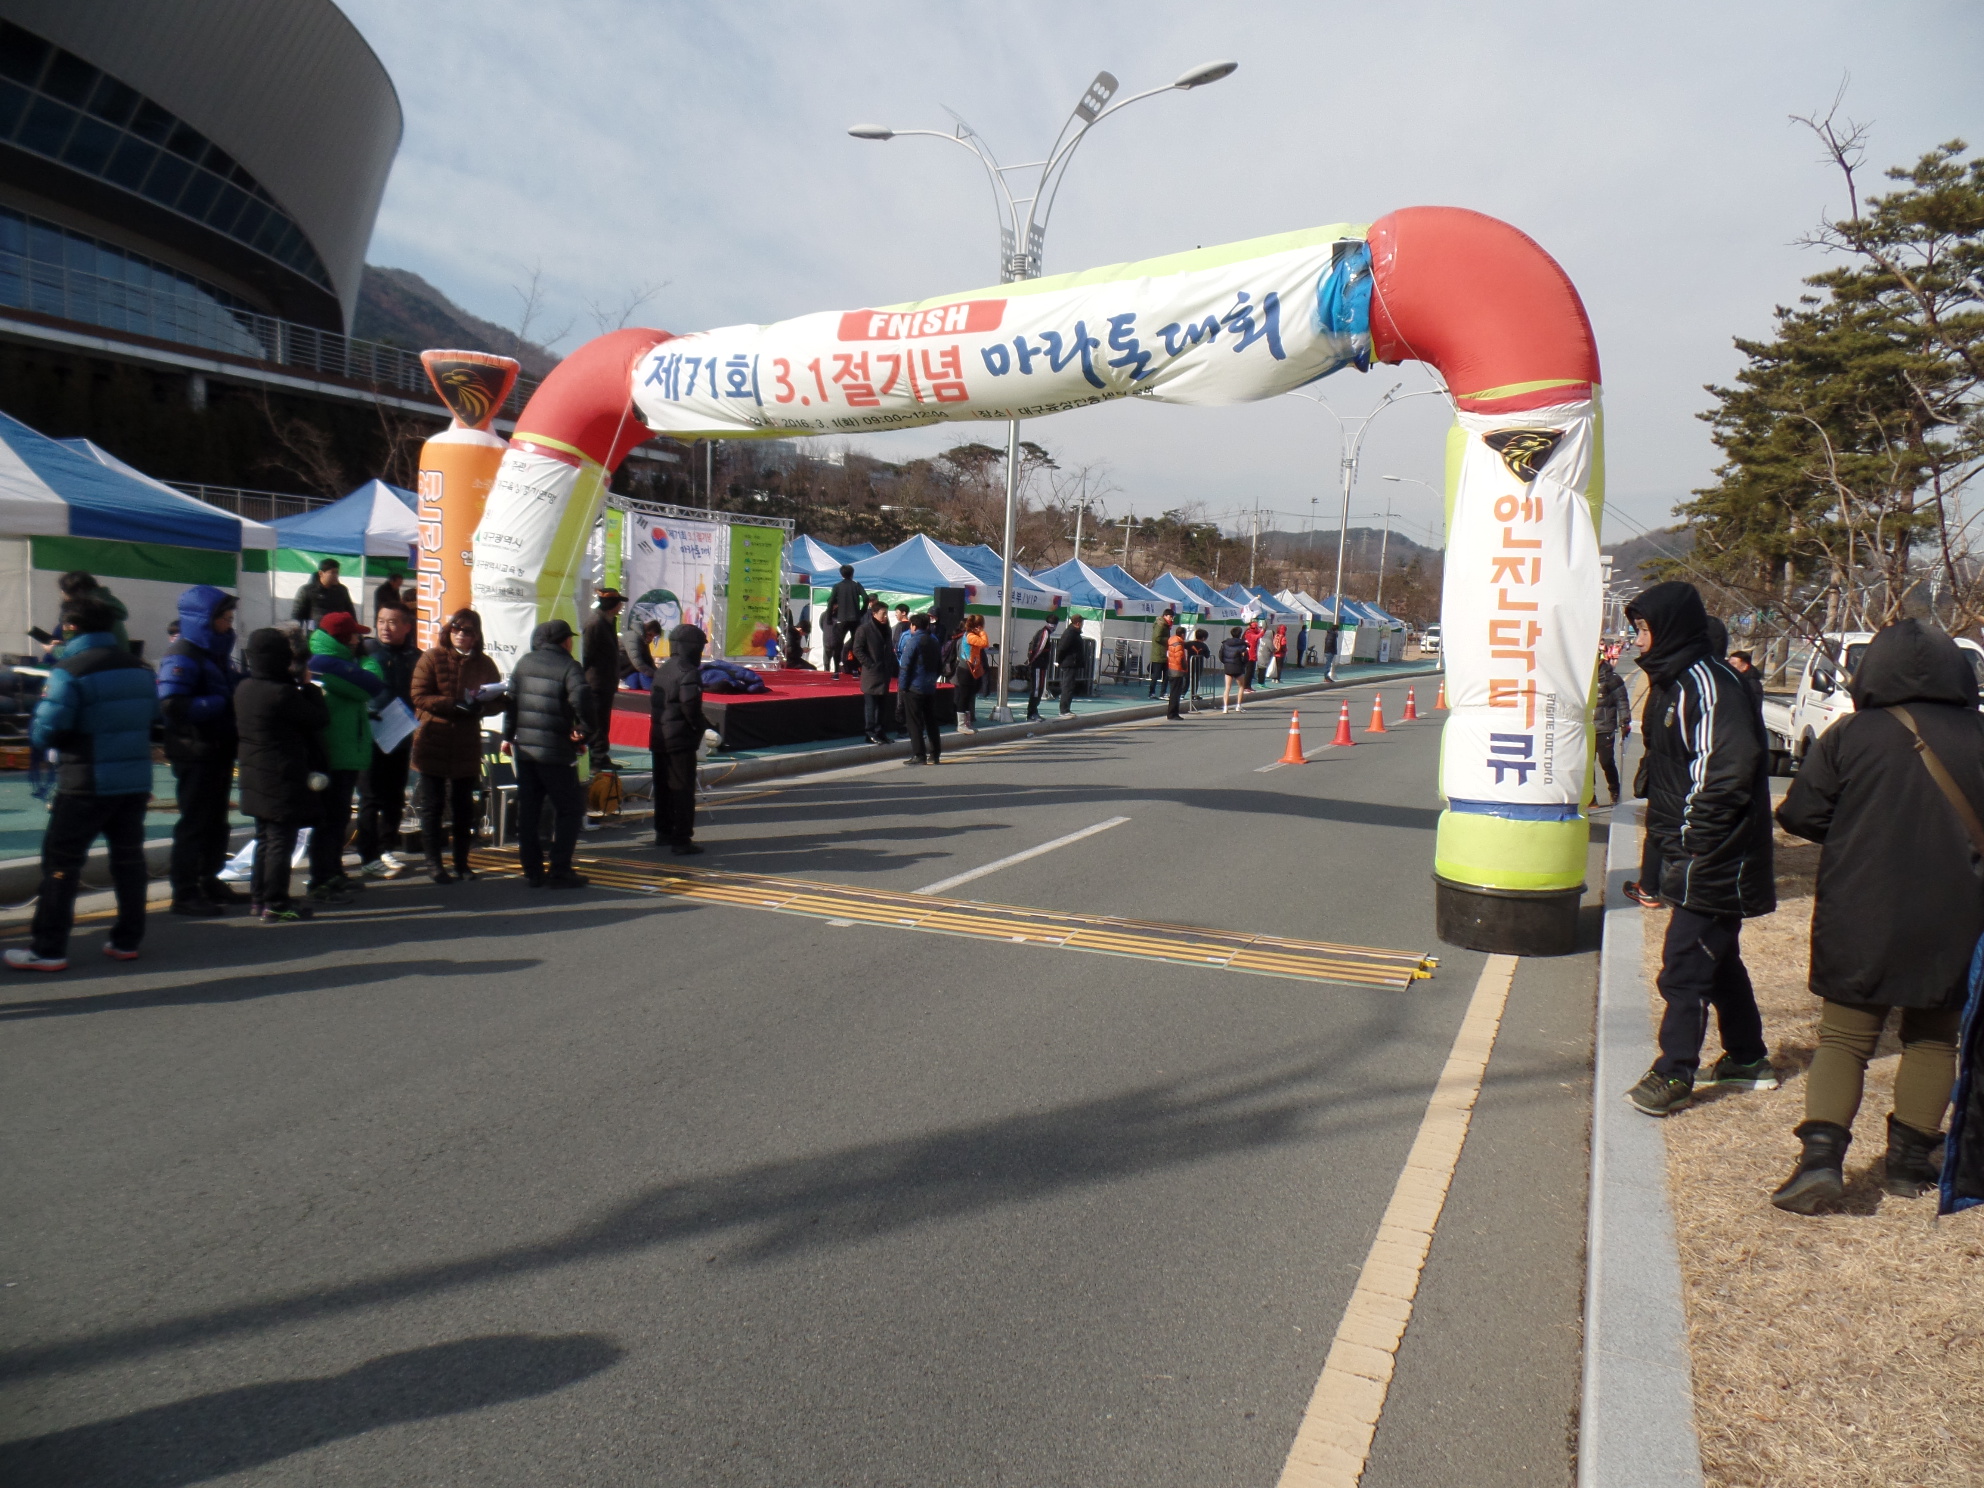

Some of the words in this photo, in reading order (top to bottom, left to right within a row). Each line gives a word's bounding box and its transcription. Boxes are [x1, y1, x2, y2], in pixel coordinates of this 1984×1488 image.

[644, 353, 764, 407] 제71회
[773, 344, 970, 408] 3.1절기념
[980, 311, 1158, 389] 마라톤
[1156, 290, 1287, 362] 대회
[868, 304, 967, 339] FNISH
